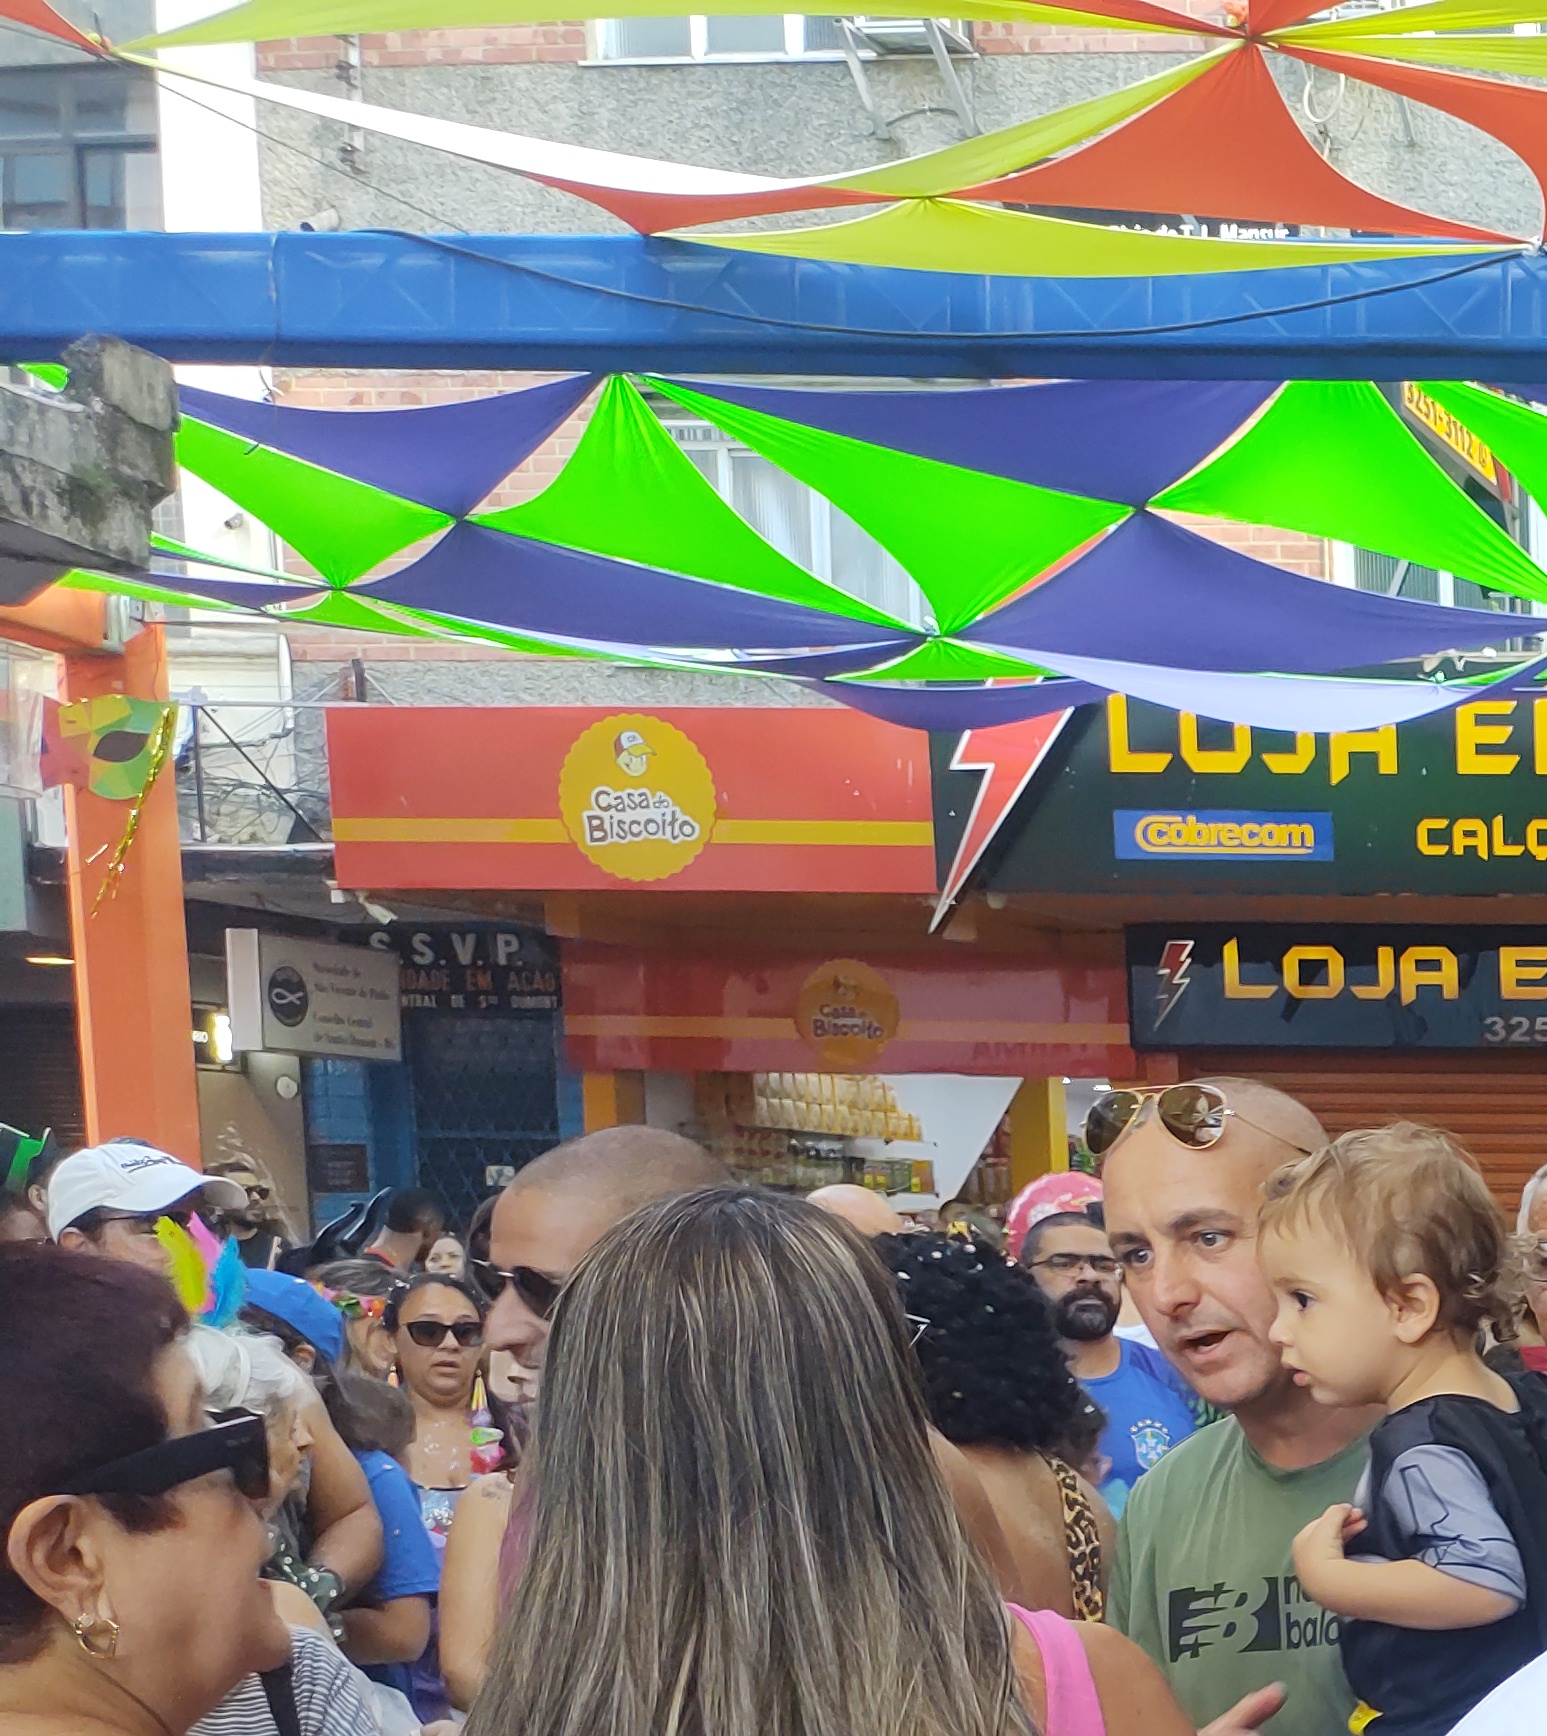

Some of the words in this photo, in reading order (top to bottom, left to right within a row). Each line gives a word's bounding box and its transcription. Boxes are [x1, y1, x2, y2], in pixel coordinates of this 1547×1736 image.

[594, 789, 650, 813] Casa
[586, 809, 696, 844] Biscoito
[1136, 815, 1314, 853] cobrecom
[1222, 936, 1460, 1006] LOJA
